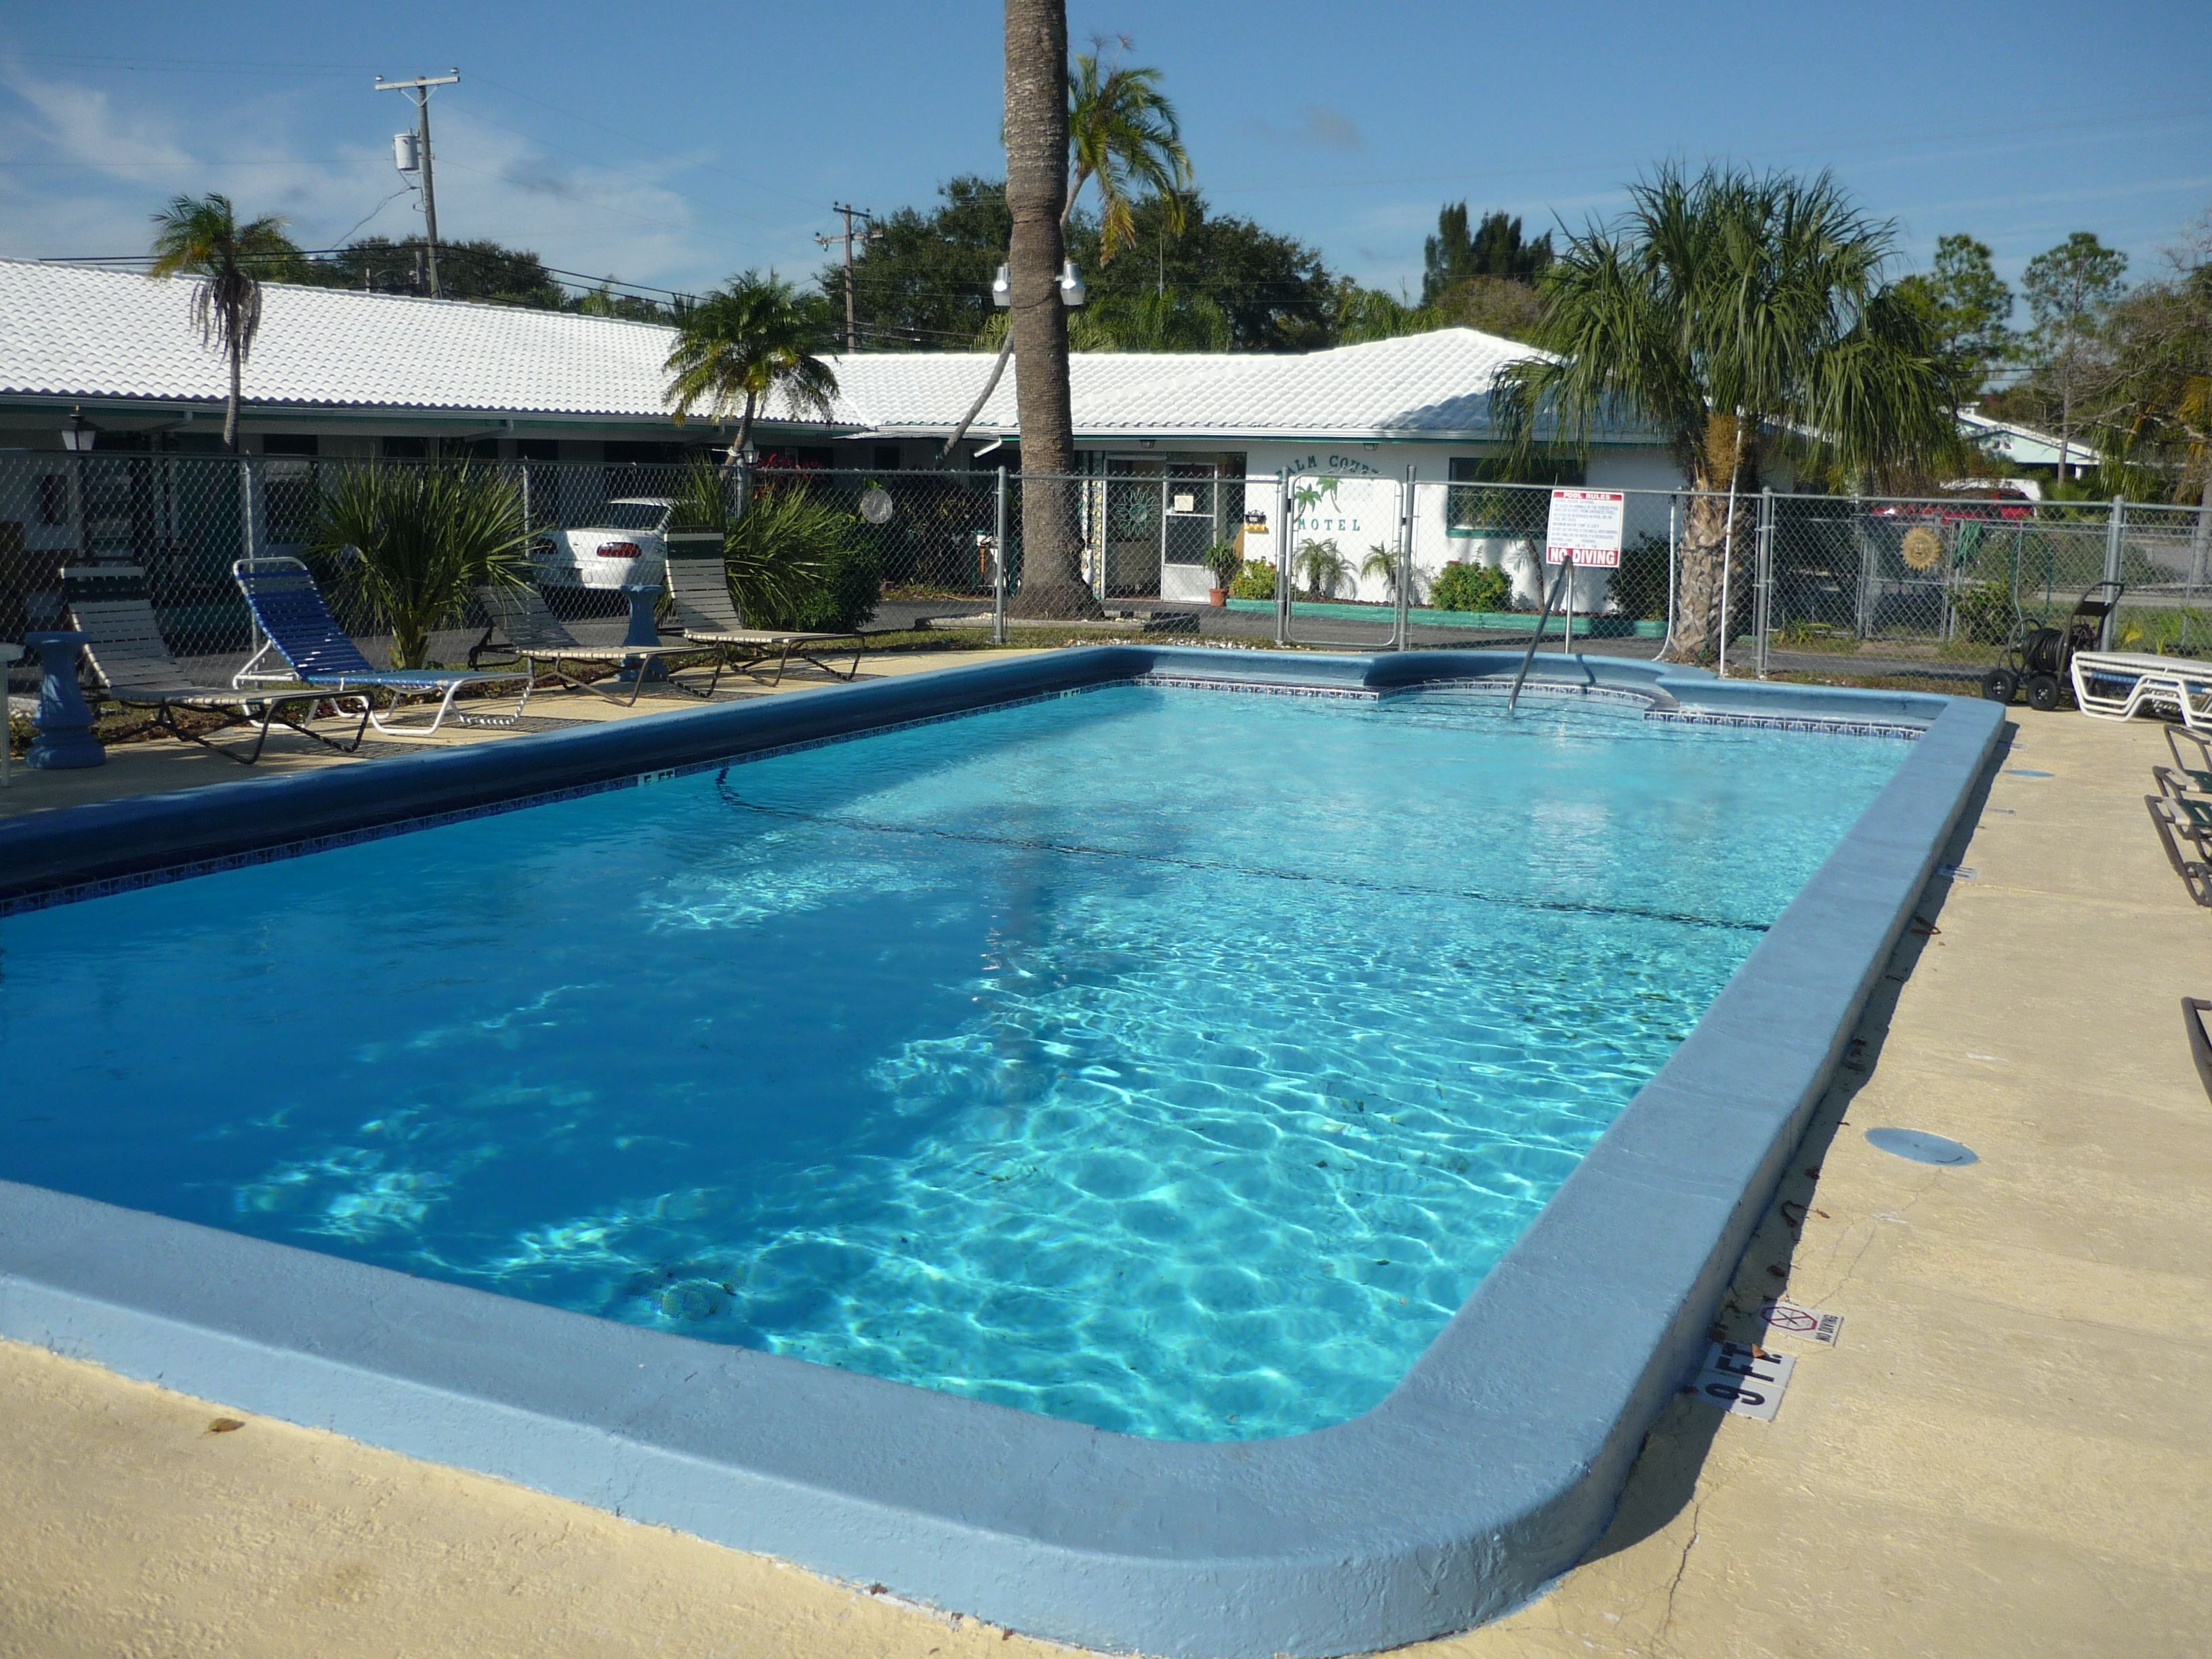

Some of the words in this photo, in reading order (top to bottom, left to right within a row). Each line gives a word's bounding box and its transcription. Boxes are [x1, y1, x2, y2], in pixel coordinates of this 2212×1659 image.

[1298, 518, 1360, 531] MOTEL
[1550, 548, 1568, 562] NO
[1572, 549, 1616, 565] DIVING
[1818, 1314, 1839, 1334] DIVING
[1815, 1332, 1832, 1342] NO
[1705, 1383, 1765, 1406] 9
